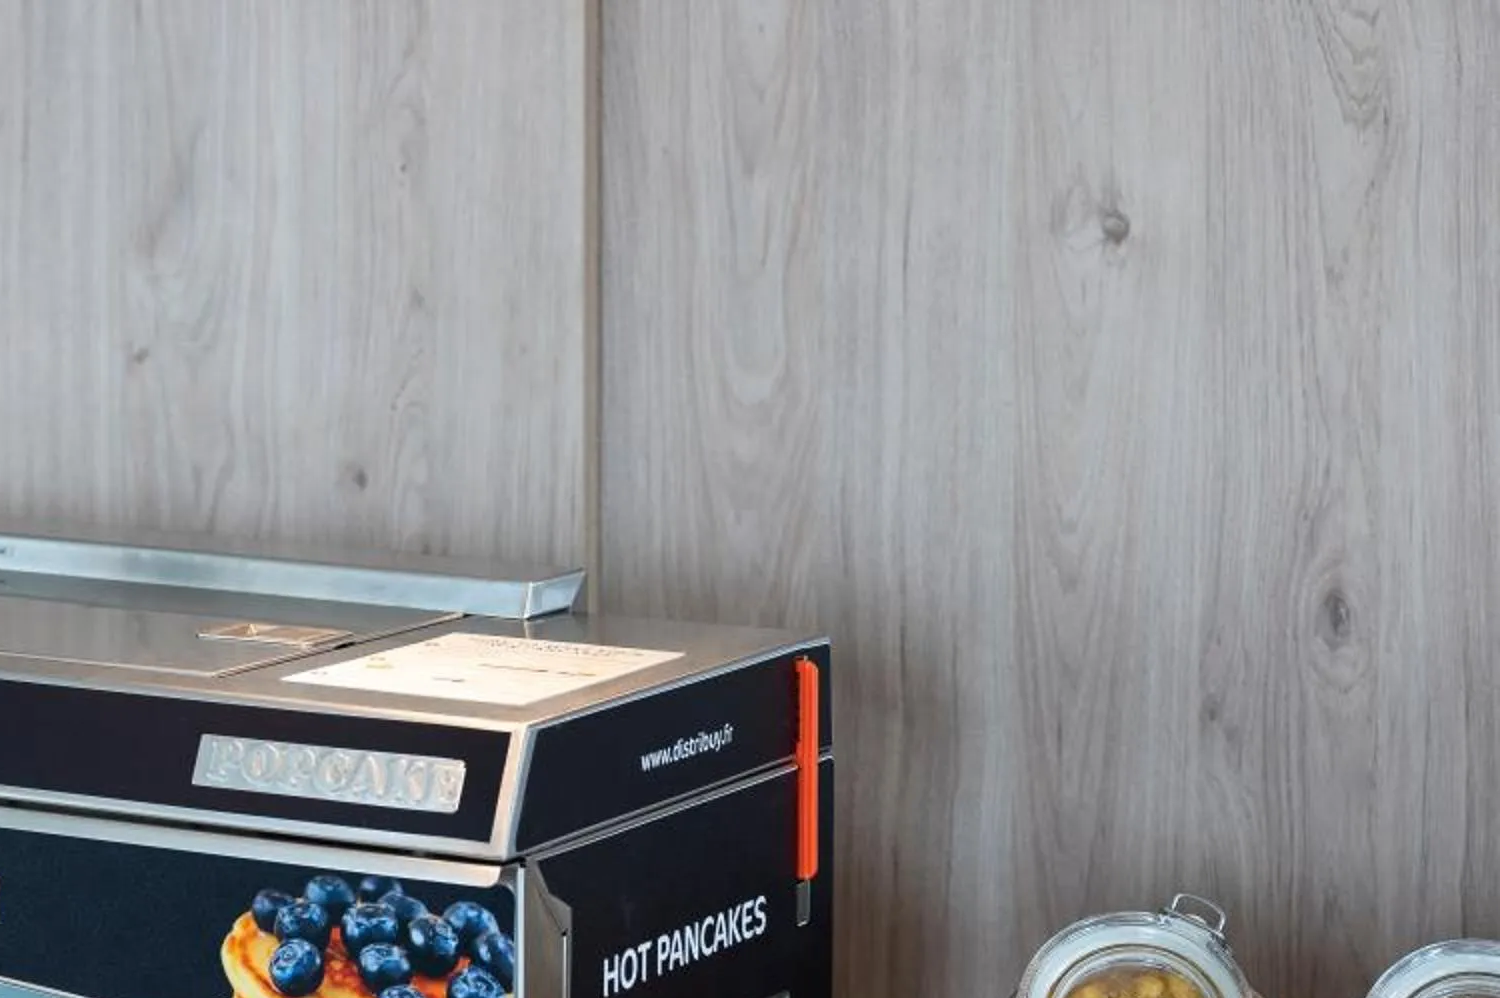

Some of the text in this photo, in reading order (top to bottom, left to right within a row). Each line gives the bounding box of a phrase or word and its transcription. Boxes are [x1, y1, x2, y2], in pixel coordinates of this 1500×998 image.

[641, 723, 733, 772] www.distribuy.fr
[603, 895, 767, 998] HOT PANCAKES
